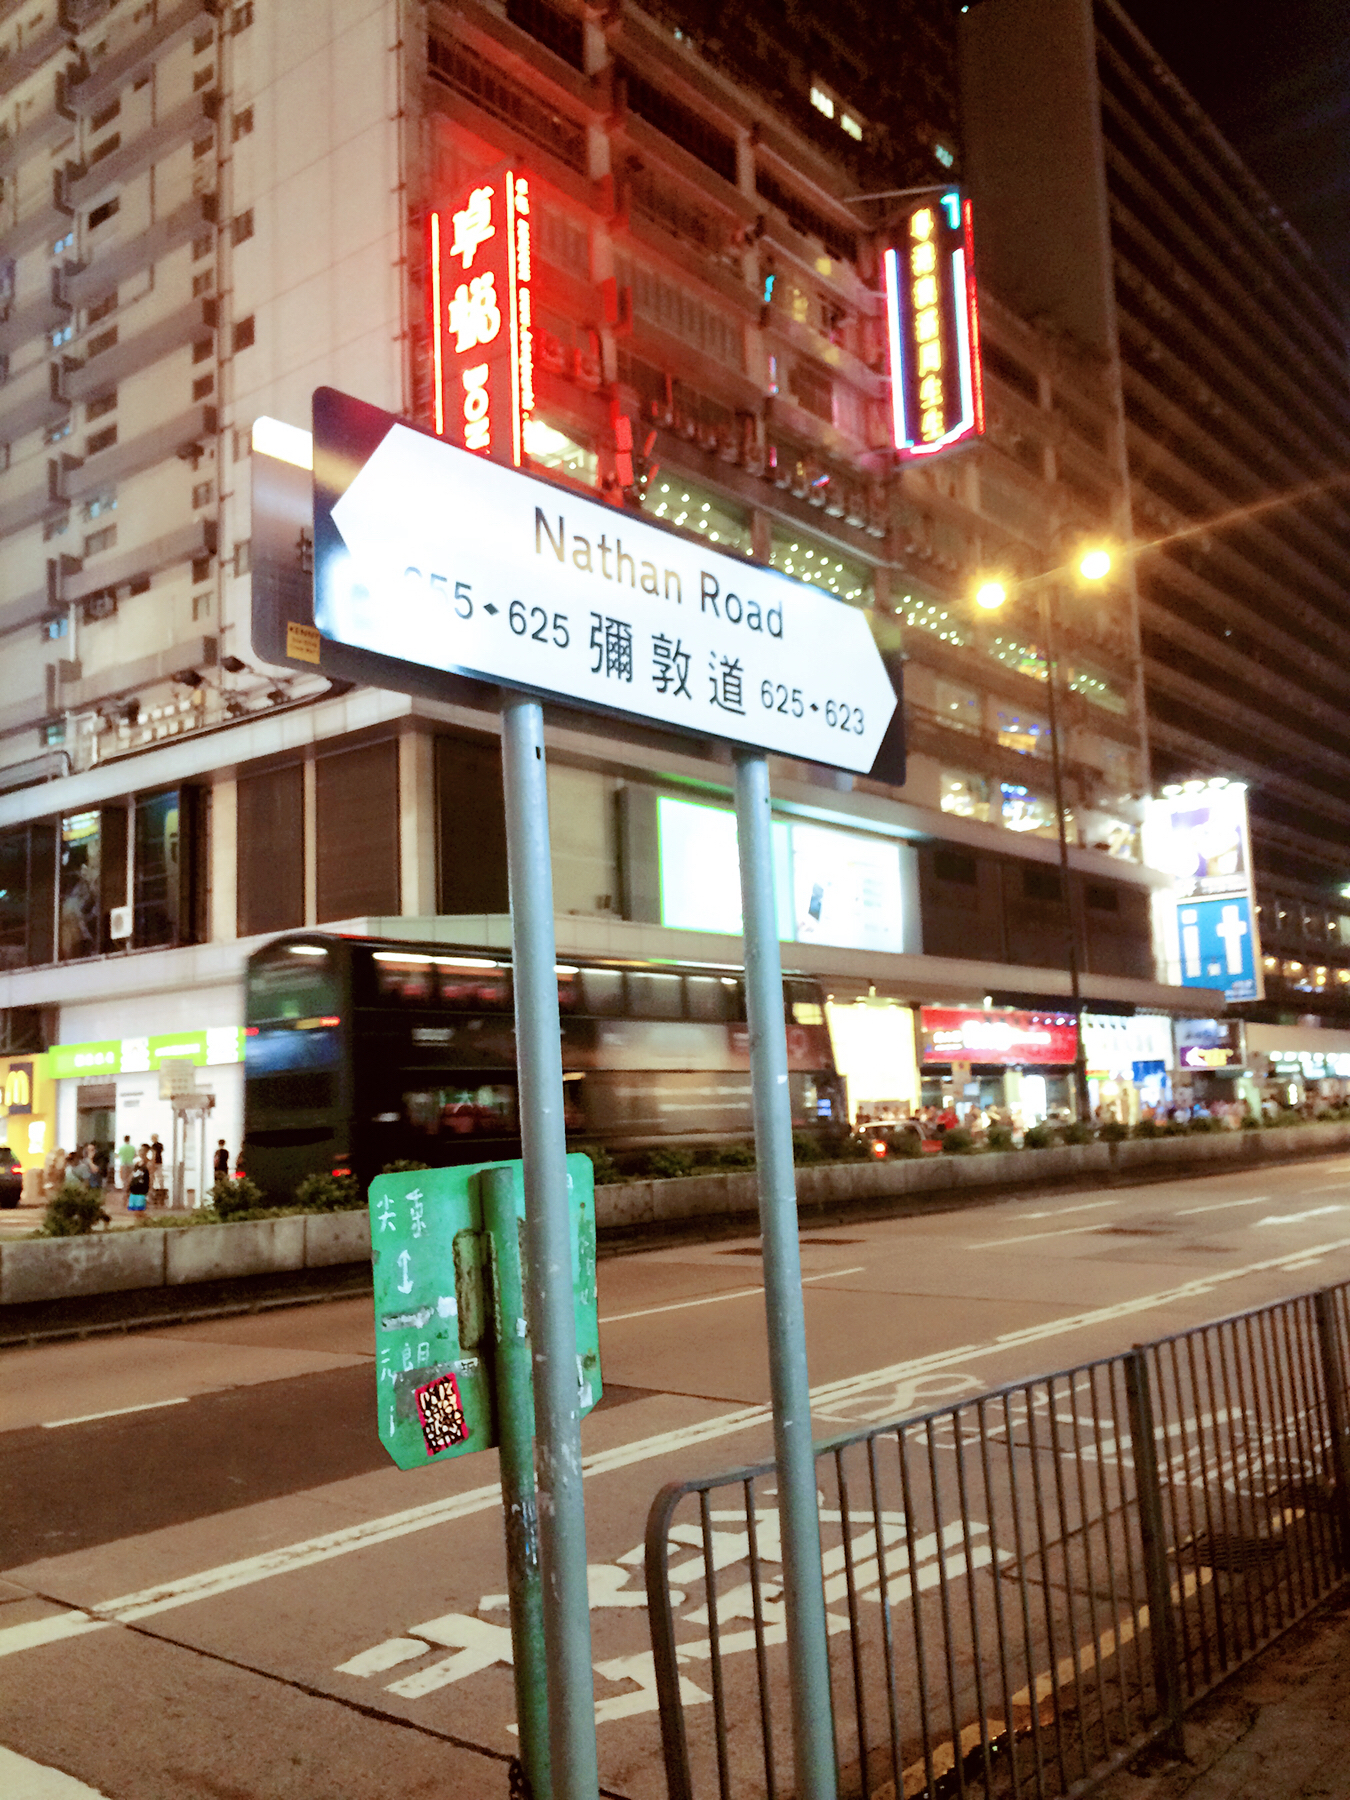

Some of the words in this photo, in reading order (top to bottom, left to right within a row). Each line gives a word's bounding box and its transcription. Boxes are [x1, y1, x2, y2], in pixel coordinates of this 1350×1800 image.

[534, 505, 683, 605] Nathan
[700, 570, 784, 640] Road
[404, 565, 474, 620] 55
[508, 600, 571, 649] 625
[590, 611, 747, 717] 彌敦道
[760, 680, 805, 718] 625
[825, 700, 865, 736] 623
